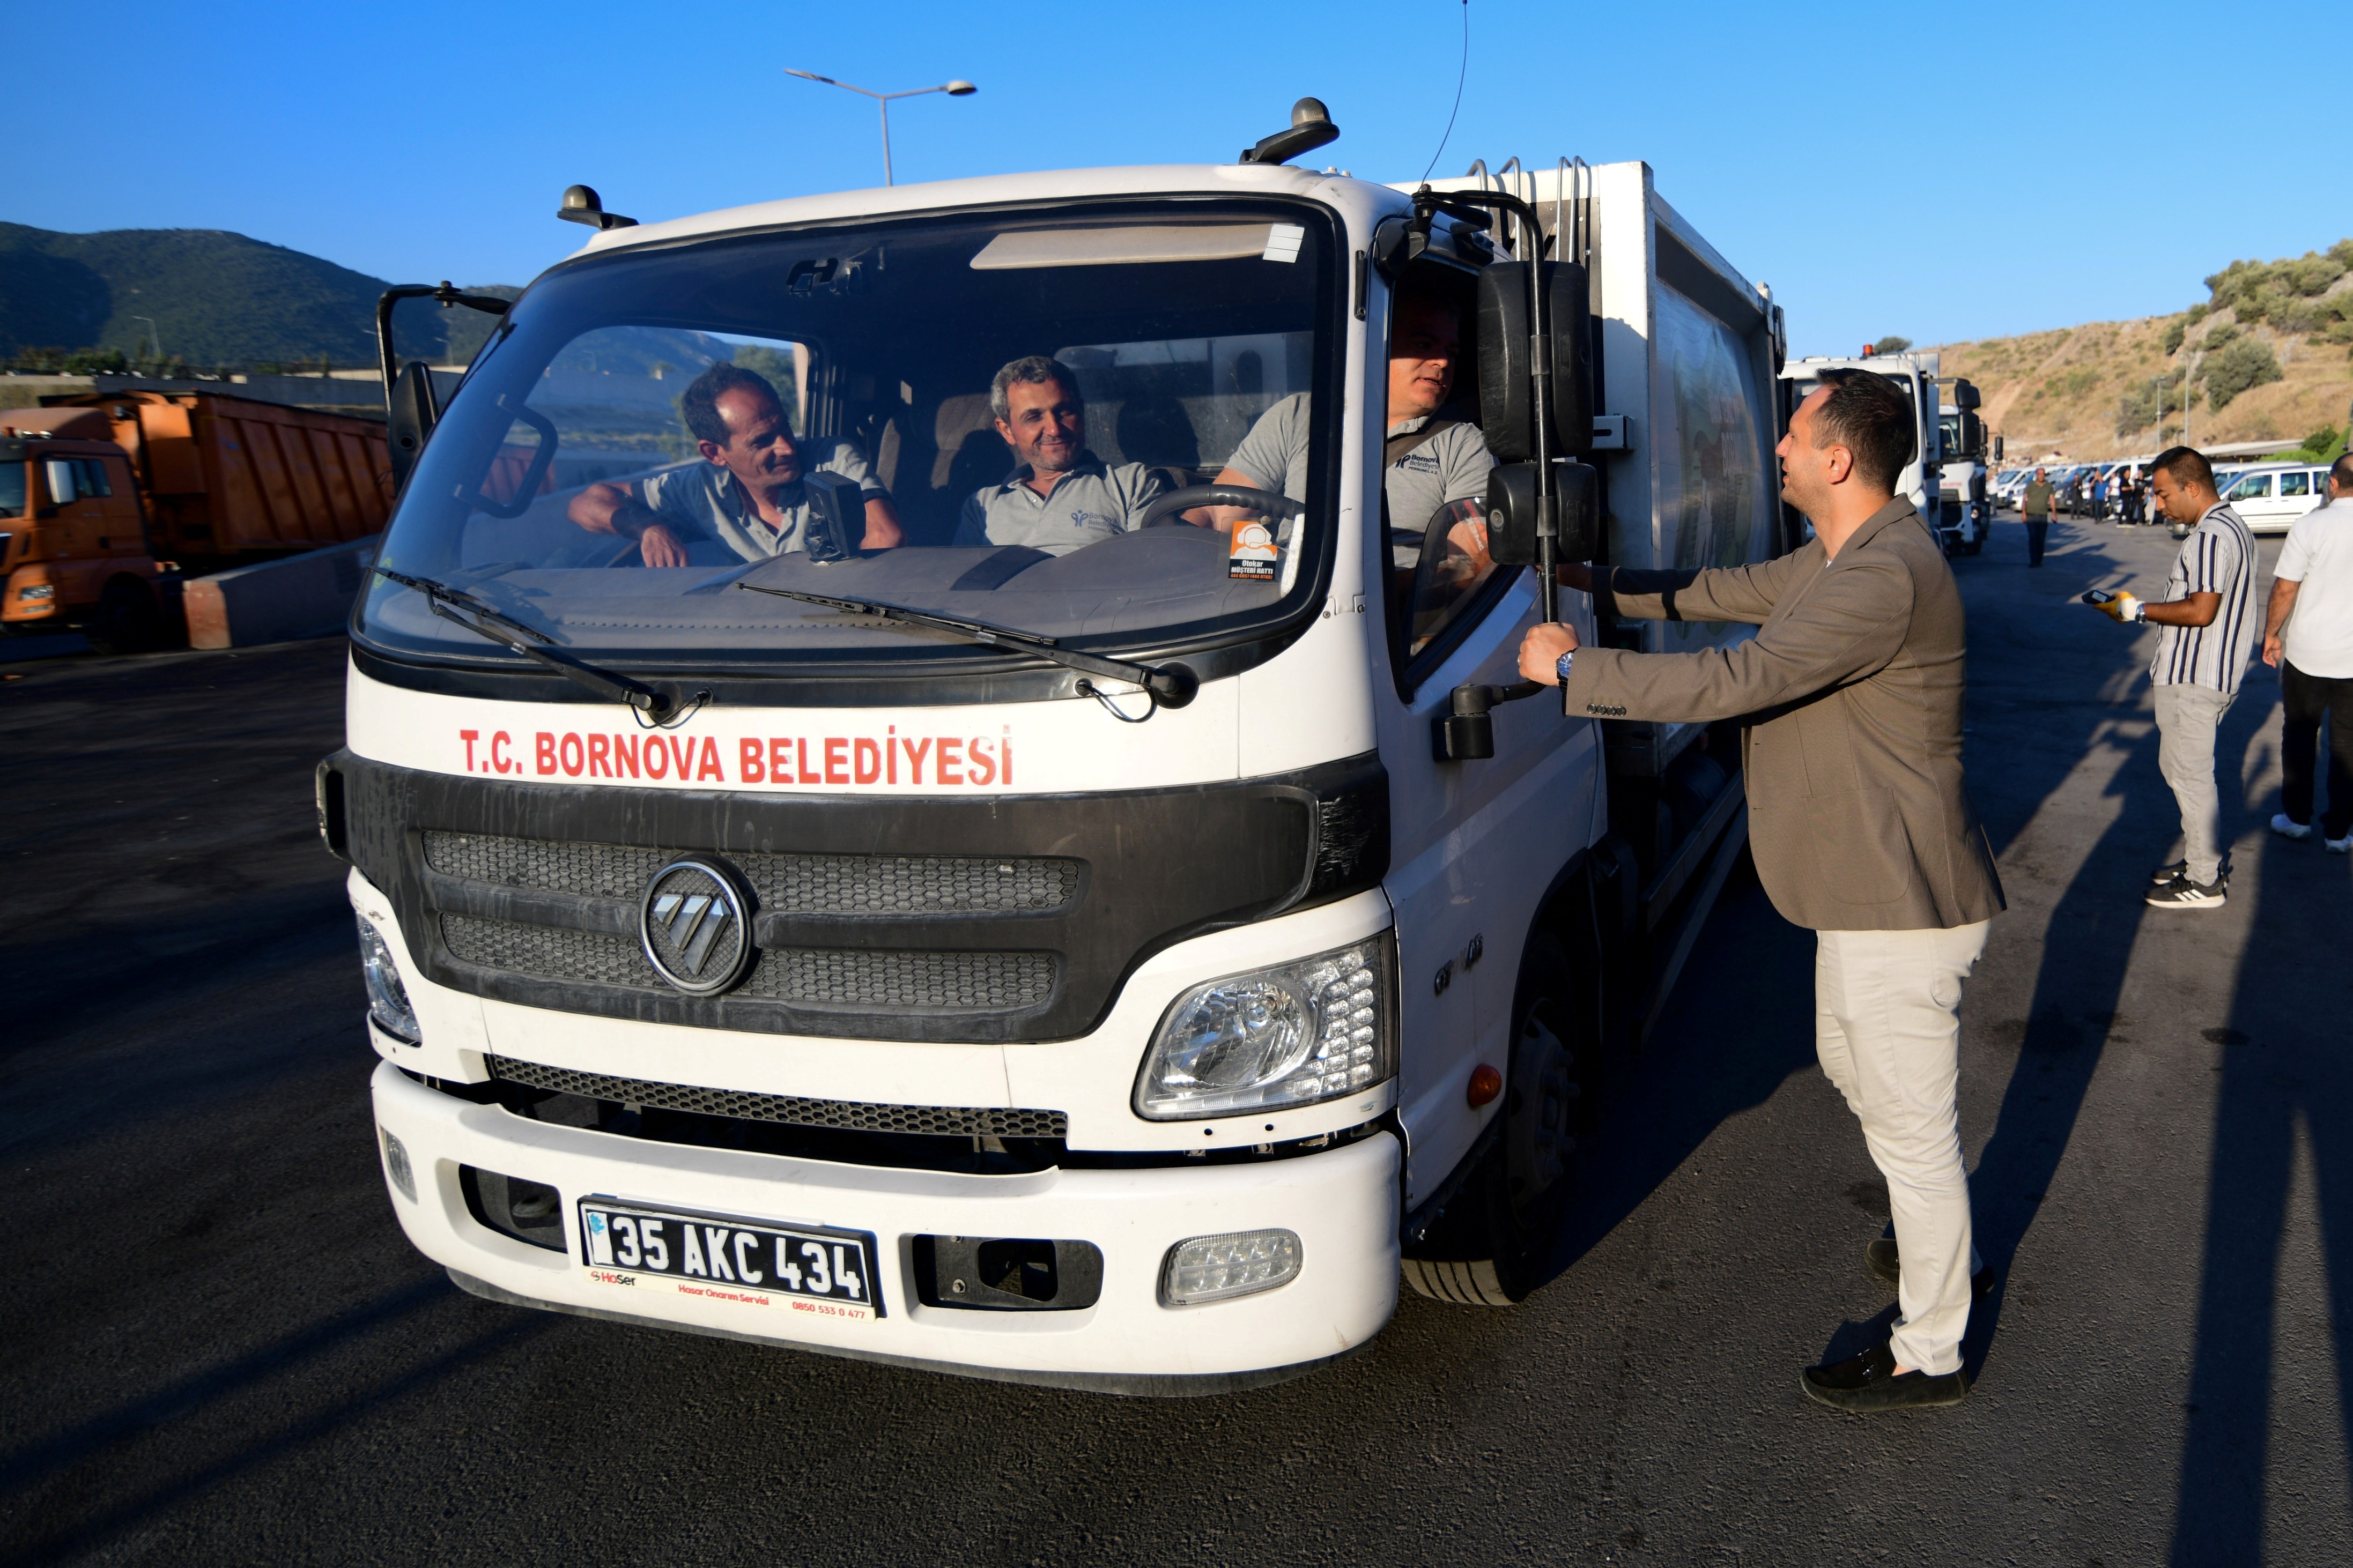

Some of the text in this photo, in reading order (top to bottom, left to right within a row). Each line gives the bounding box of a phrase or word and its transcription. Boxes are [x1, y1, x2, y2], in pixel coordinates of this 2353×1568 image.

[1089, 512, 1117, 524] Bornova
[1231, 566, 1256, 574] MÜŞTERİ
[460, 724, 1012, 785] T.C. BORNOVA BELEDİYESİ
[612, 1216, 861, 1298] 35 AKC 434
[678, 1284, 704, 1295] Hasar
[706, 1289, 738, 1301] Onarım
[739, 1294, 769, 1305] Servisi
[792, 1301, 815, 1312] 0850
[818, 1305, 836, 1315] 533
[839, 1308, 845, 1316] 0
[848, 1310, 865, 1319] 477
